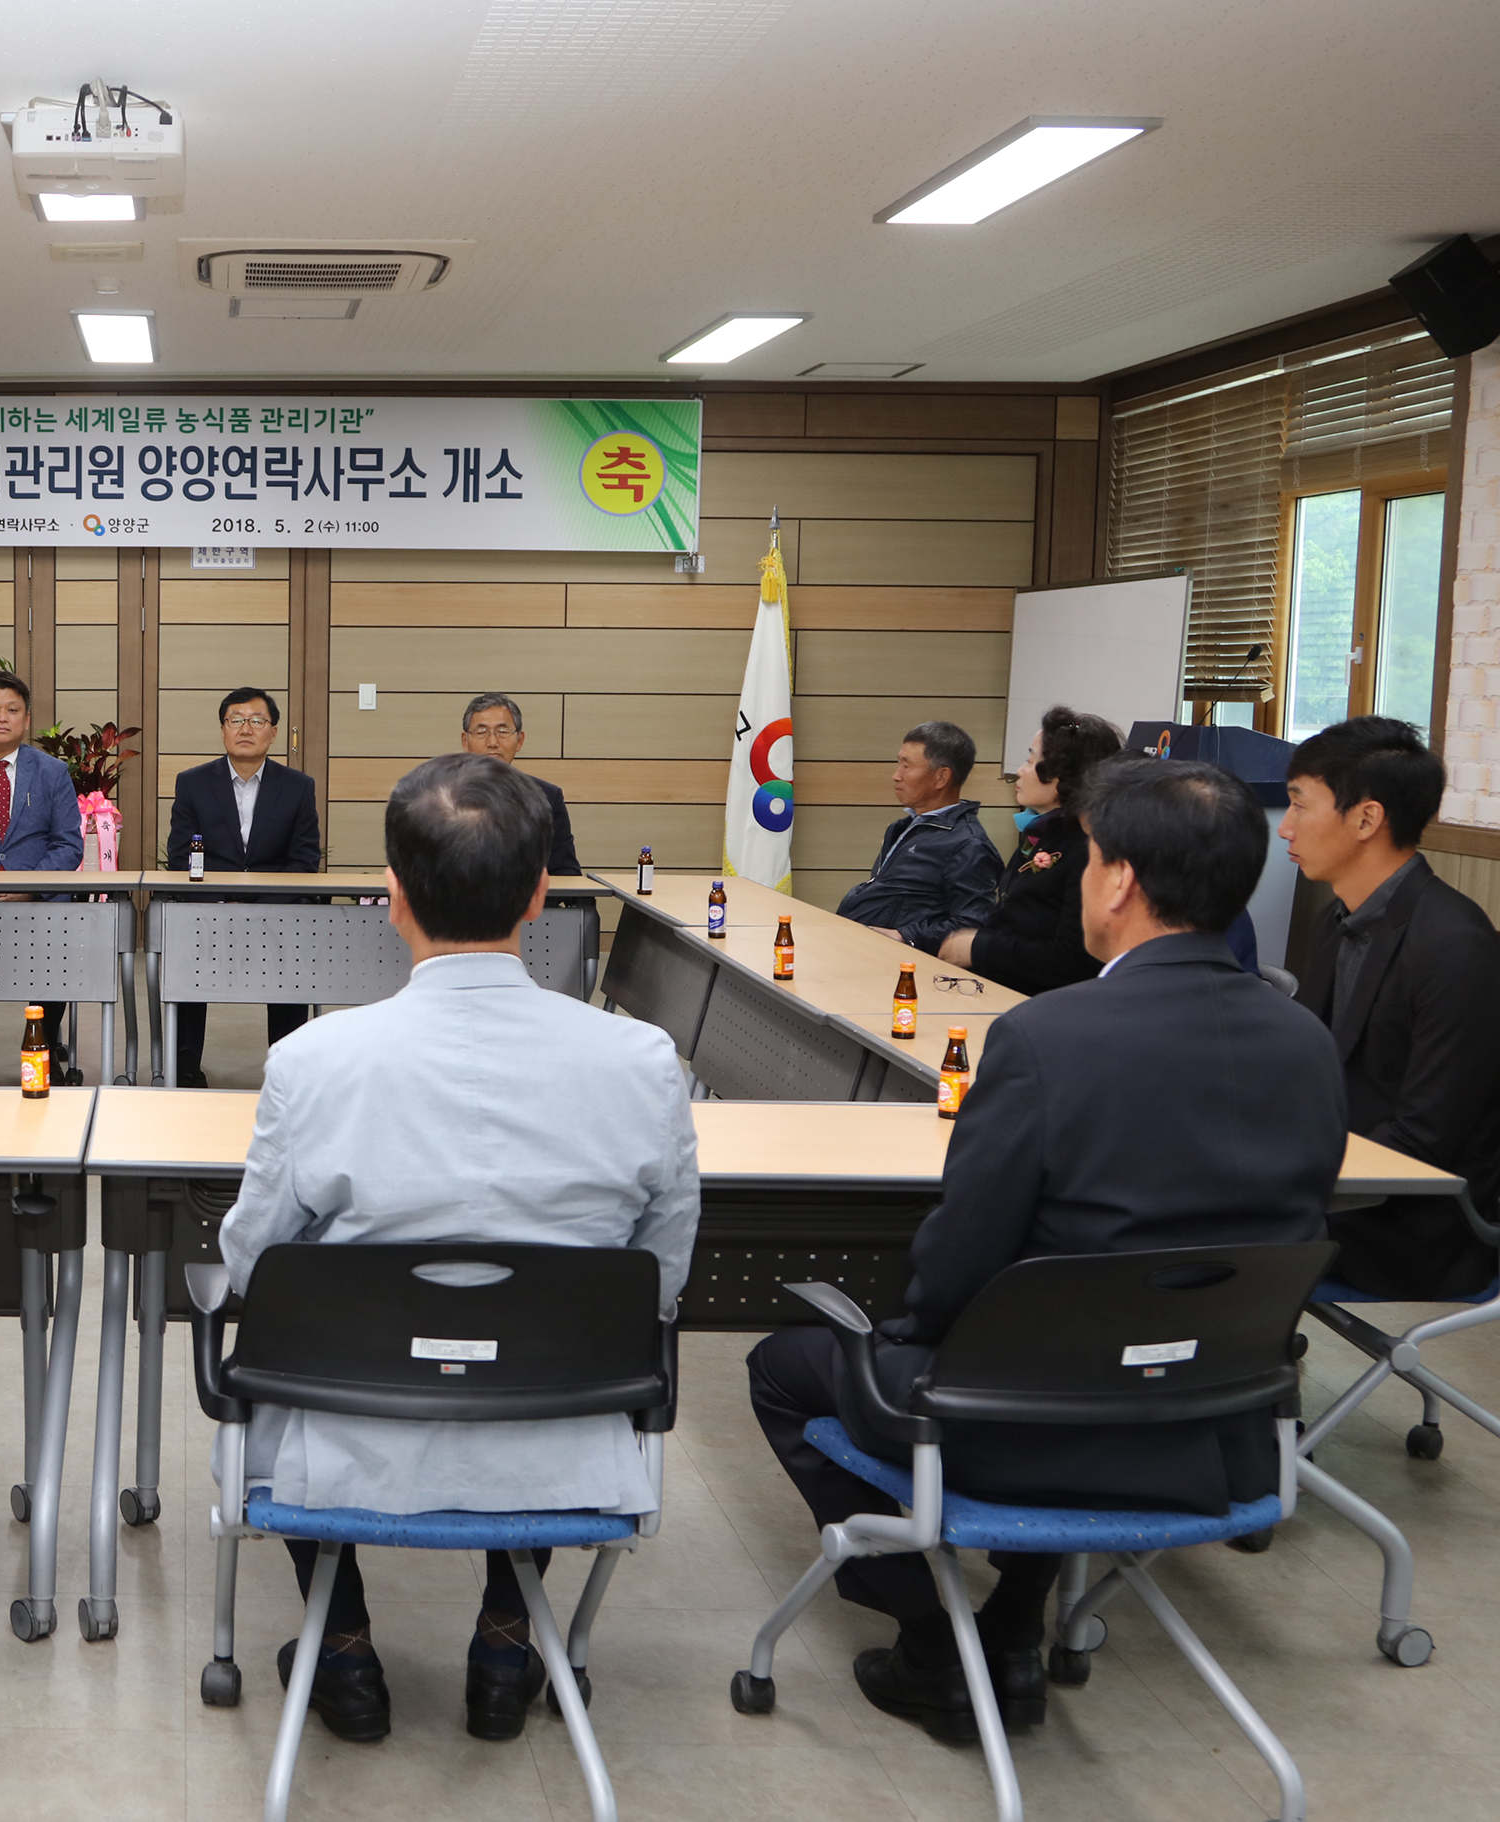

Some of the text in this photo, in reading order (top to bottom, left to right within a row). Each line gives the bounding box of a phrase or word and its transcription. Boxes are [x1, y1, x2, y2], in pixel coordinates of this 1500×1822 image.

[65, 407, 168, 433] 세계일류
[175, 406, 253, 434] 농식품
[259, 405, 375, 434] 관리기관”
[137, 445, 428, 502] 양양연락사무소
[442, 447, 524, 503] 개소
[596, 446, 651, 503] 축
[108, 517, 150, 534] 양양군
[211, 518, 261, 534] 2018.
[274, 518, 291, 534] 5.
[345, 520, 380, 533] 11:00
